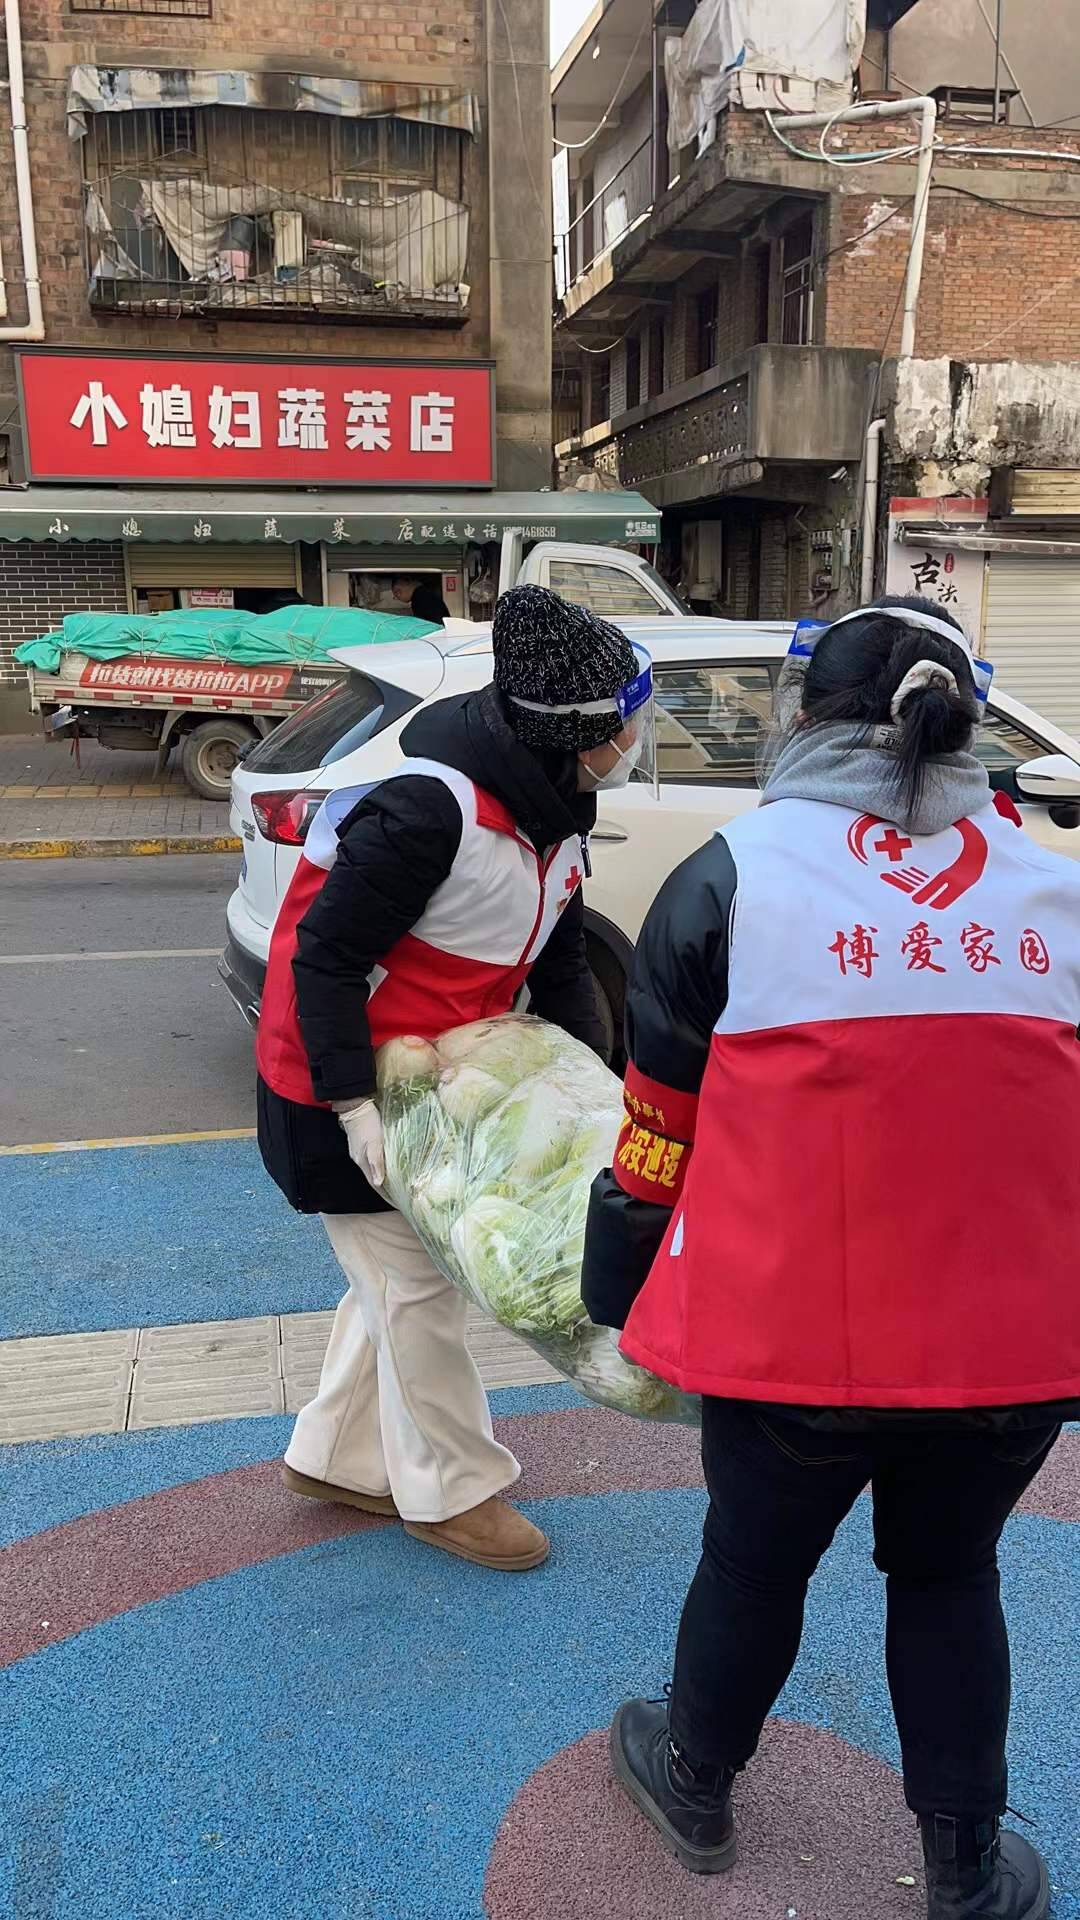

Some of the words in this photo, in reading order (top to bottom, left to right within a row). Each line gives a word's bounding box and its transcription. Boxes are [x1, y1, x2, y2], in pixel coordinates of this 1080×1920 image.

[70, 381, 456, 453] 小媳妇蔬菜店
[49, 517, 414, 541] 小媳妇蔬菜店
[420, 523, 498, 539] 配送电话
[88, 663, 285, 695] 拉货就找货拉拉APP
[828, 921, 1050, 979] 博爱家园
